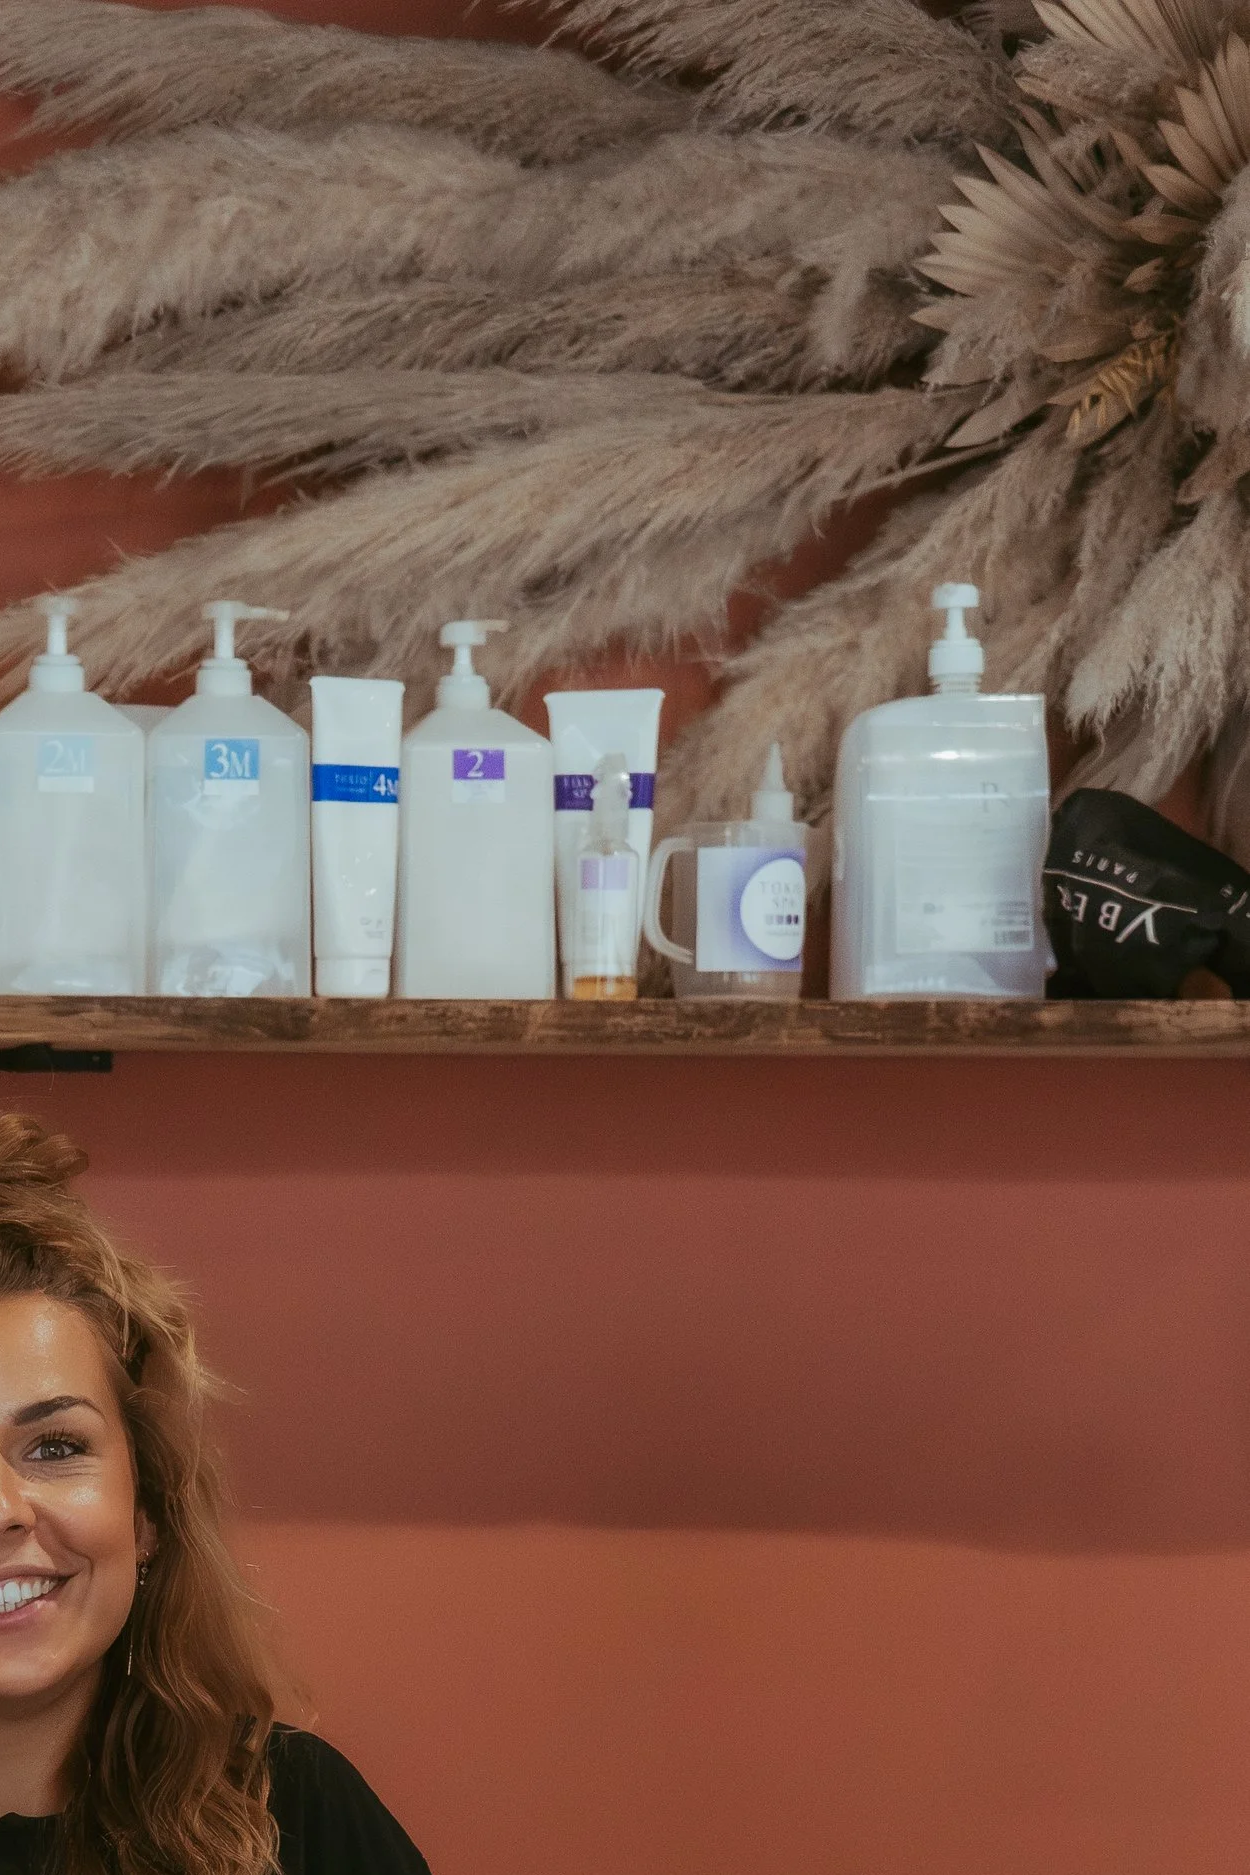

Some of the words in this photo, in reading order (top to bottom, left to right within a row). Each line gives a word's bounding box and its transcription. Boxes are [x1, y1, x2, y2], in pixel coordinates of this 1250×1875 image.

[43, 739, 87, 774] 2M
[210, 742, 252, 778] 3M
[466, 750, 485, 778] 2
